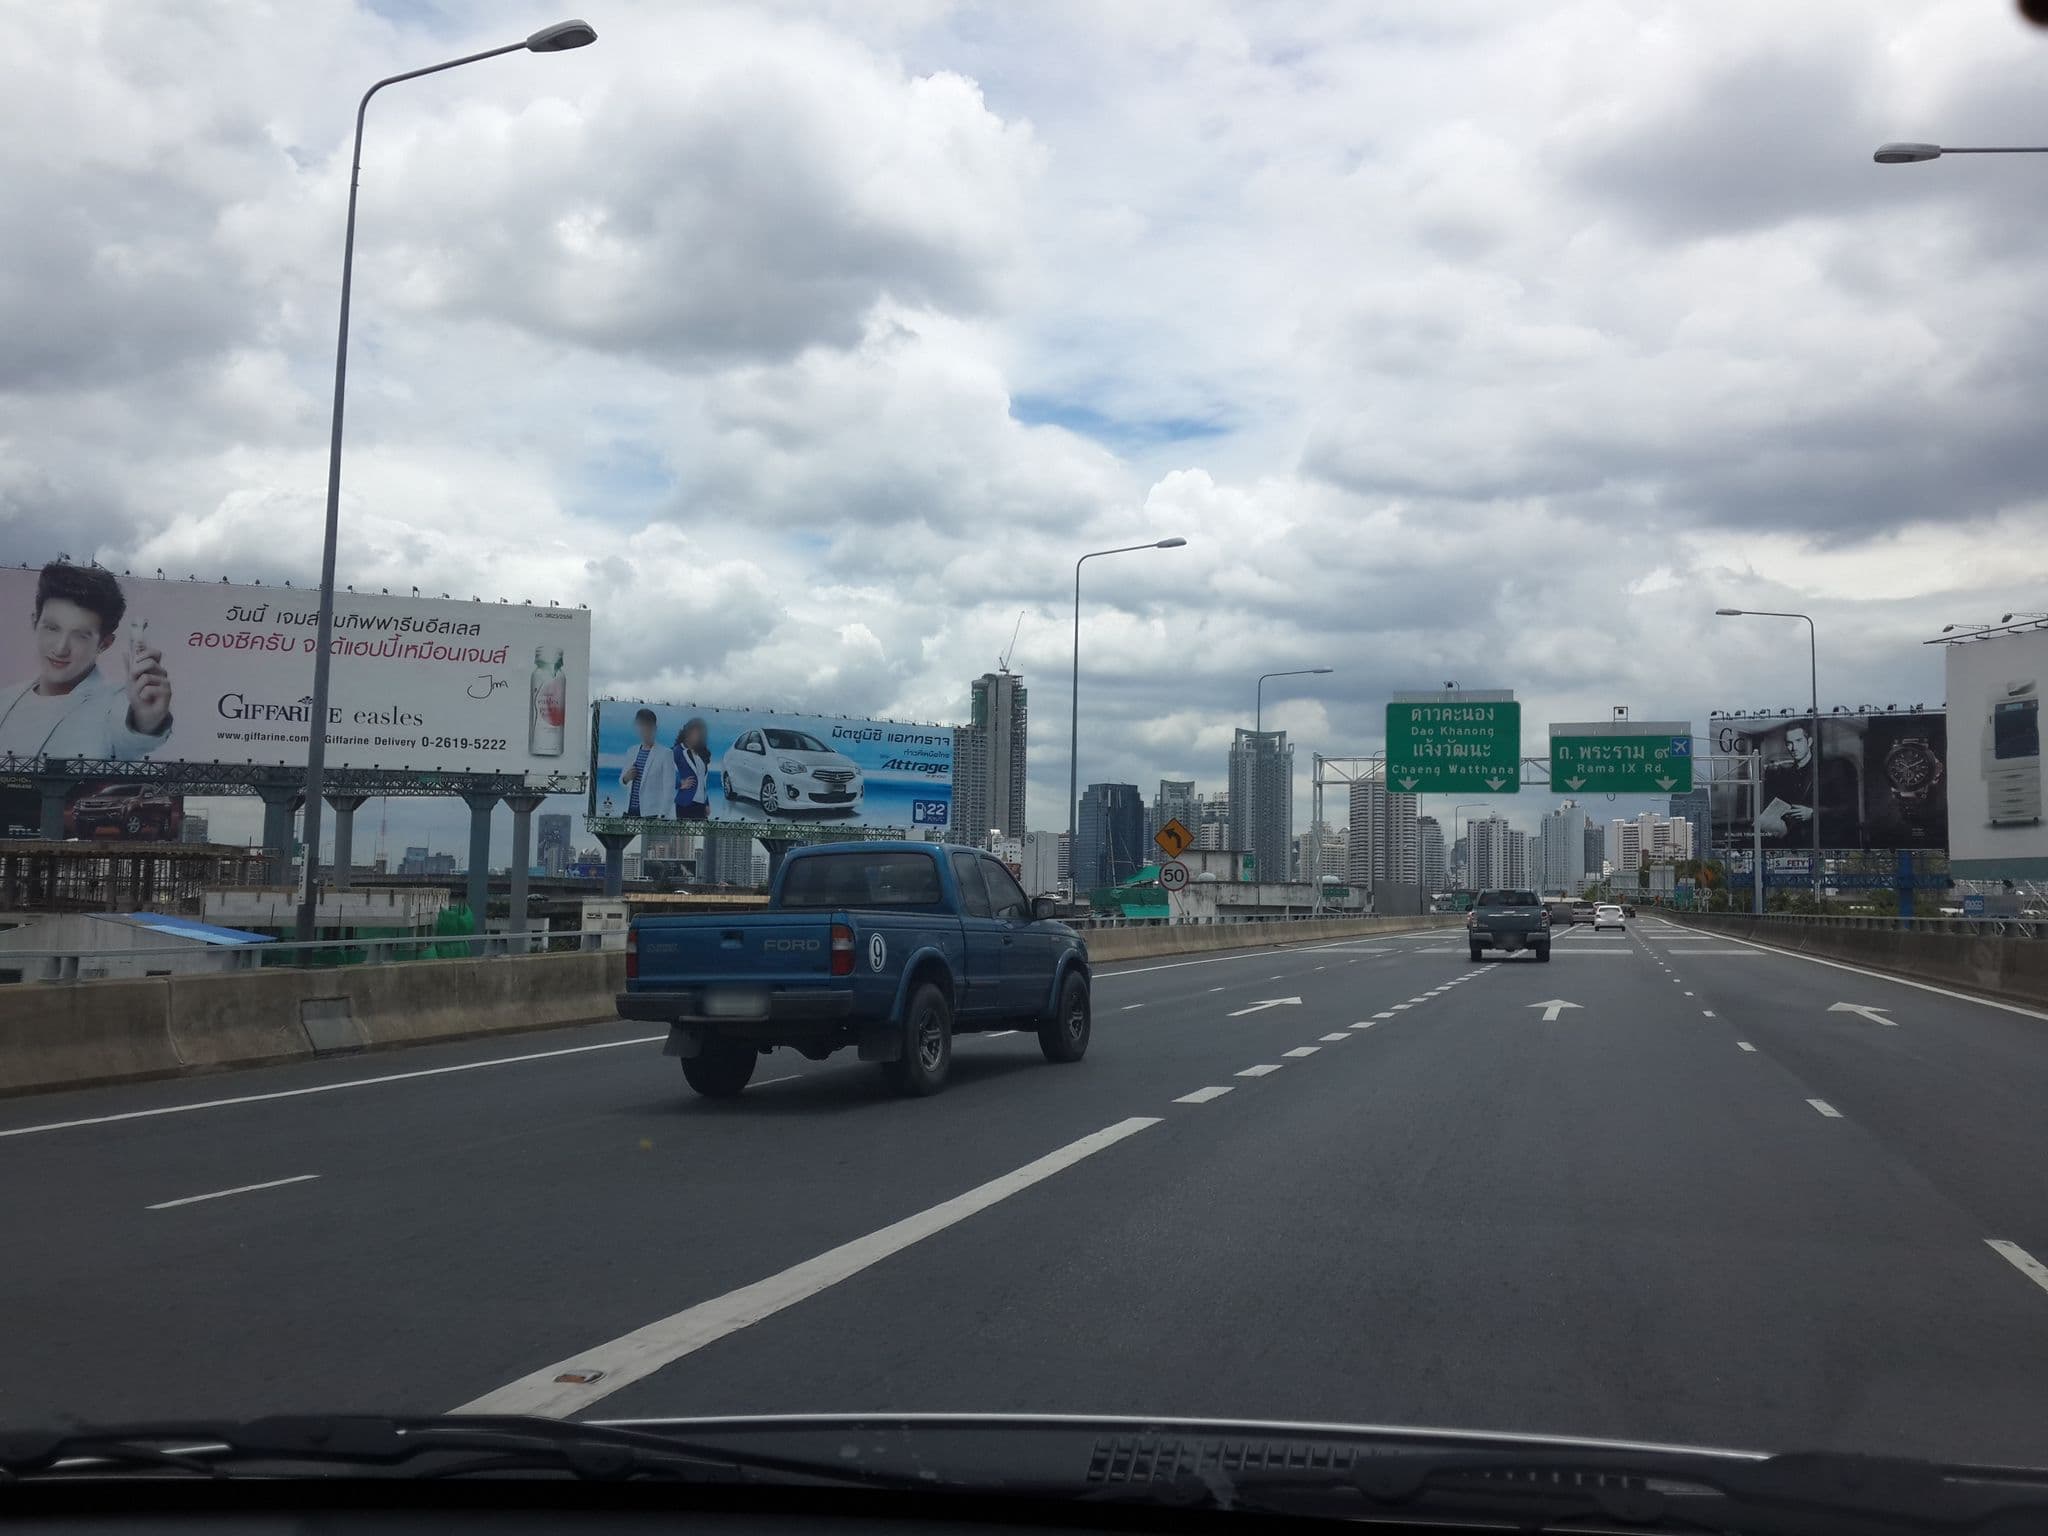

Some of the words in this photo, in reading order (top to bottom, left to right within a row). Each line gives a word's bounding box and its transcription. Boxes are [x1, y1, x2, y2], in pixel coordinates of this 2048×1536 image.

[226, 603, 270, 623] วันนี้
[217, 693, 343, 724] GIFFARIE
[353, 705, 424, 727] easles
[1411, 707, 1495, 722] ดาวคะนอง
[1411, 726, 1434, 736] Dao
[1440, 726, 1495, 738] Khanong
[216, 731, 309, 743] www.giffarine.com
[374, 735, 416, 749] Delivery
[421, 735, 507, 751] 0-2619-5222
[1412, 738, 1491, 758] แจ้งวัฒนะ
[1579, 744, 1645, 761] พระราม
[881, 759, 950, 774] Attrage
[1391, 764, 1441, 776] Chaeng
[1449, 764, 1514, 775] Watthana
[1576, 763, 1615, 773] Rama
[1622, 763, 1636, 773] IX
[1644, 763, 1665, 773] Rd.
[926, 803, 946, 816] 22
[1164, 868, 1185, 882] 50
[763, 939, 821, 951] FORD
